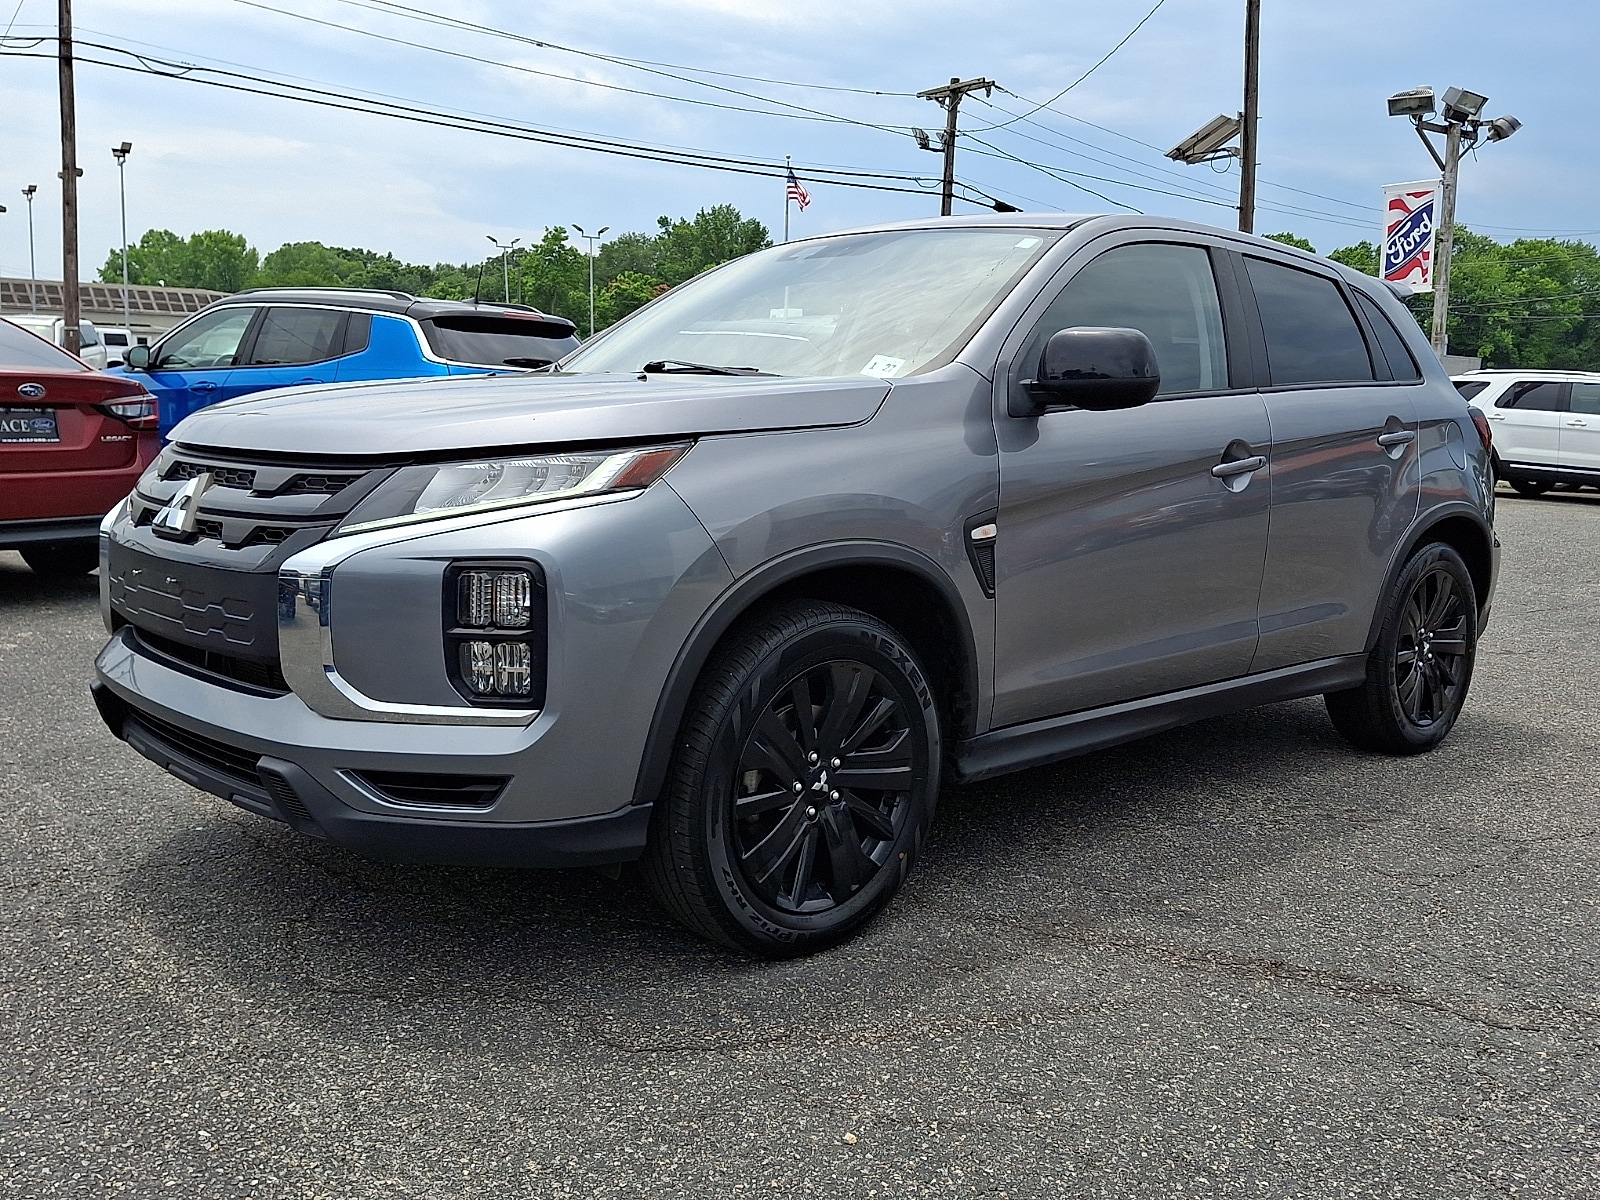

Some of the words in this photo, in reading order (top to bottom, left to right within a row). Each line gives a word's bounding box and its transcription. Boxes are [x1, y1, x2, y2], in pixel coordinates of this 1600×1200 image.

[1386, 212, 1432, 264] Ford
[0, 419, 30, 433] ACE
[862, 631, 932, 710] NEXEN
